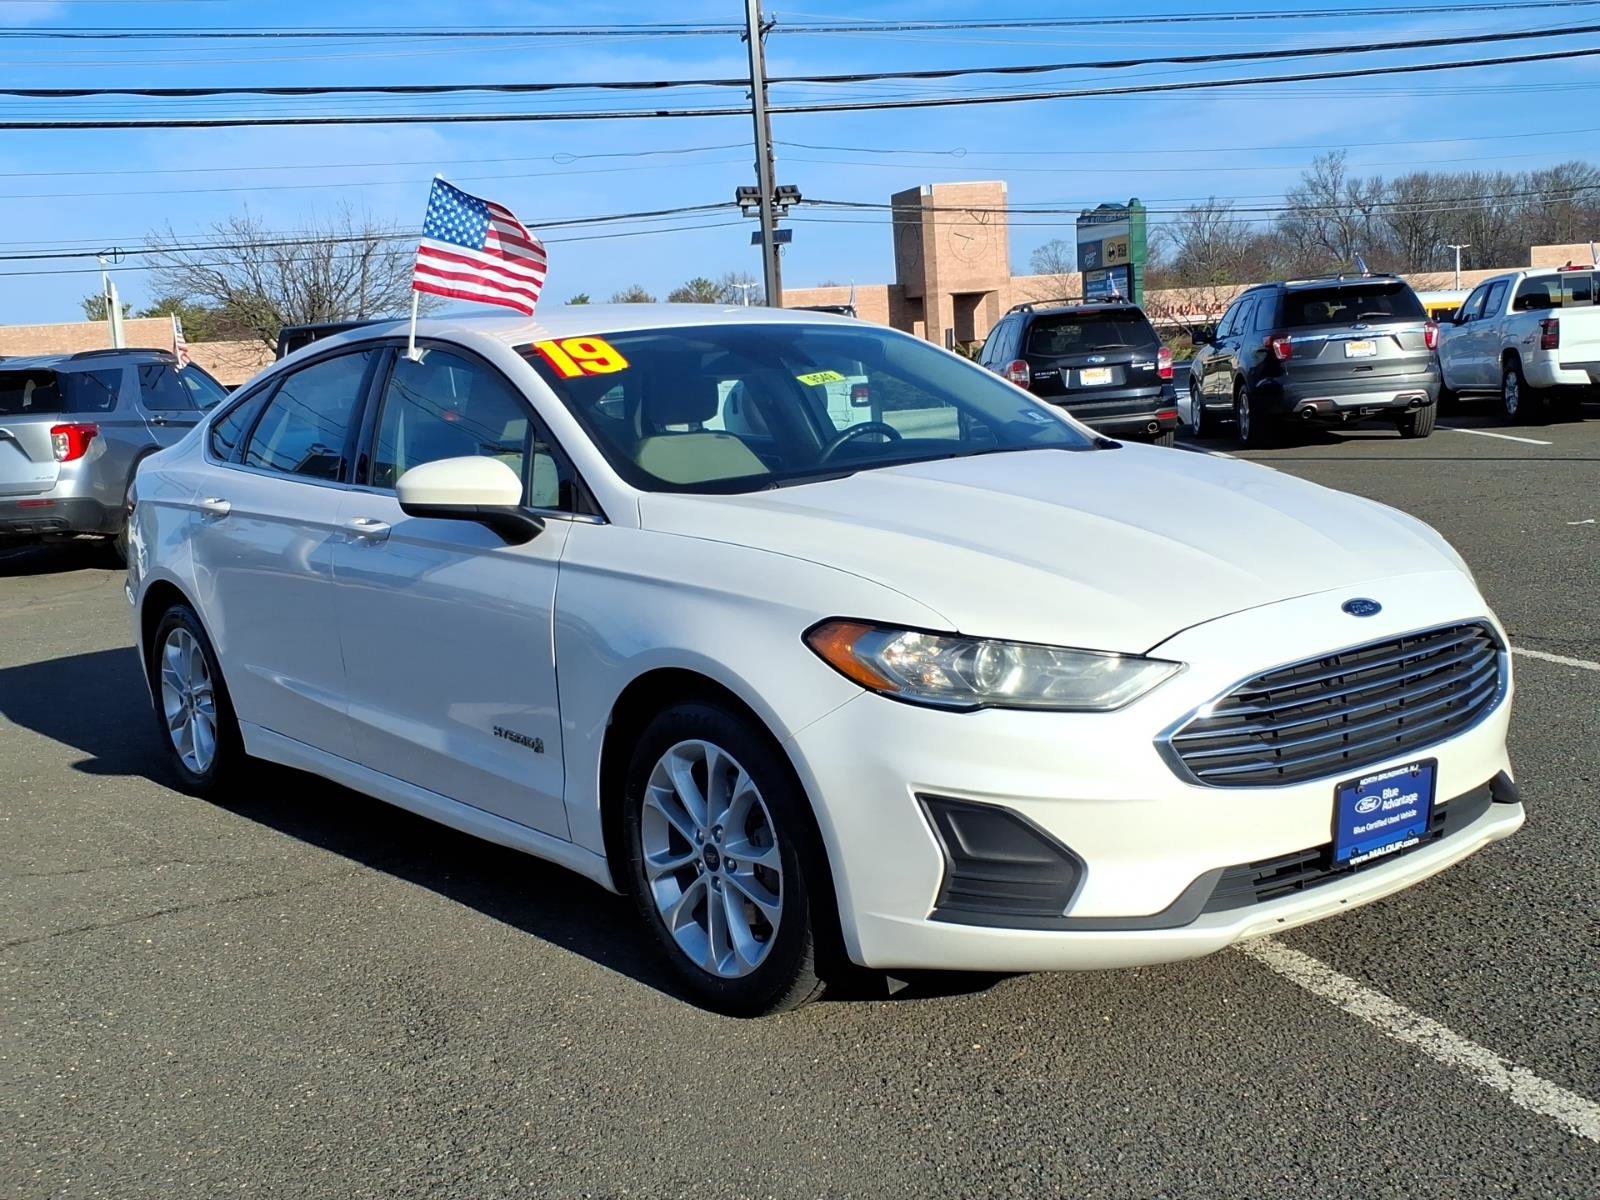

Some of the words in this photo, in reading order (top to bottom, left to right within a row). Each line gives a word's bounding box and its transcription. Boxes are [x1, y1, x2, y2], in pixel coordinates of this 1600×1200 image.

[533, 336, 630, 379] 19
[1347, 599, 1377, 613] Ford
[1382, 788, 1399, 799] Blue
[1382, 792, 1418, 811] Advantage
[1359, 797, 1377, 811] Ford
[1353, 825, 1366, 835] Blue
[1366, 817, 1388, 831] Certified
[1388, 813, 1400, 825] Used
[1400, 808, 1417, 820] Vehicle
